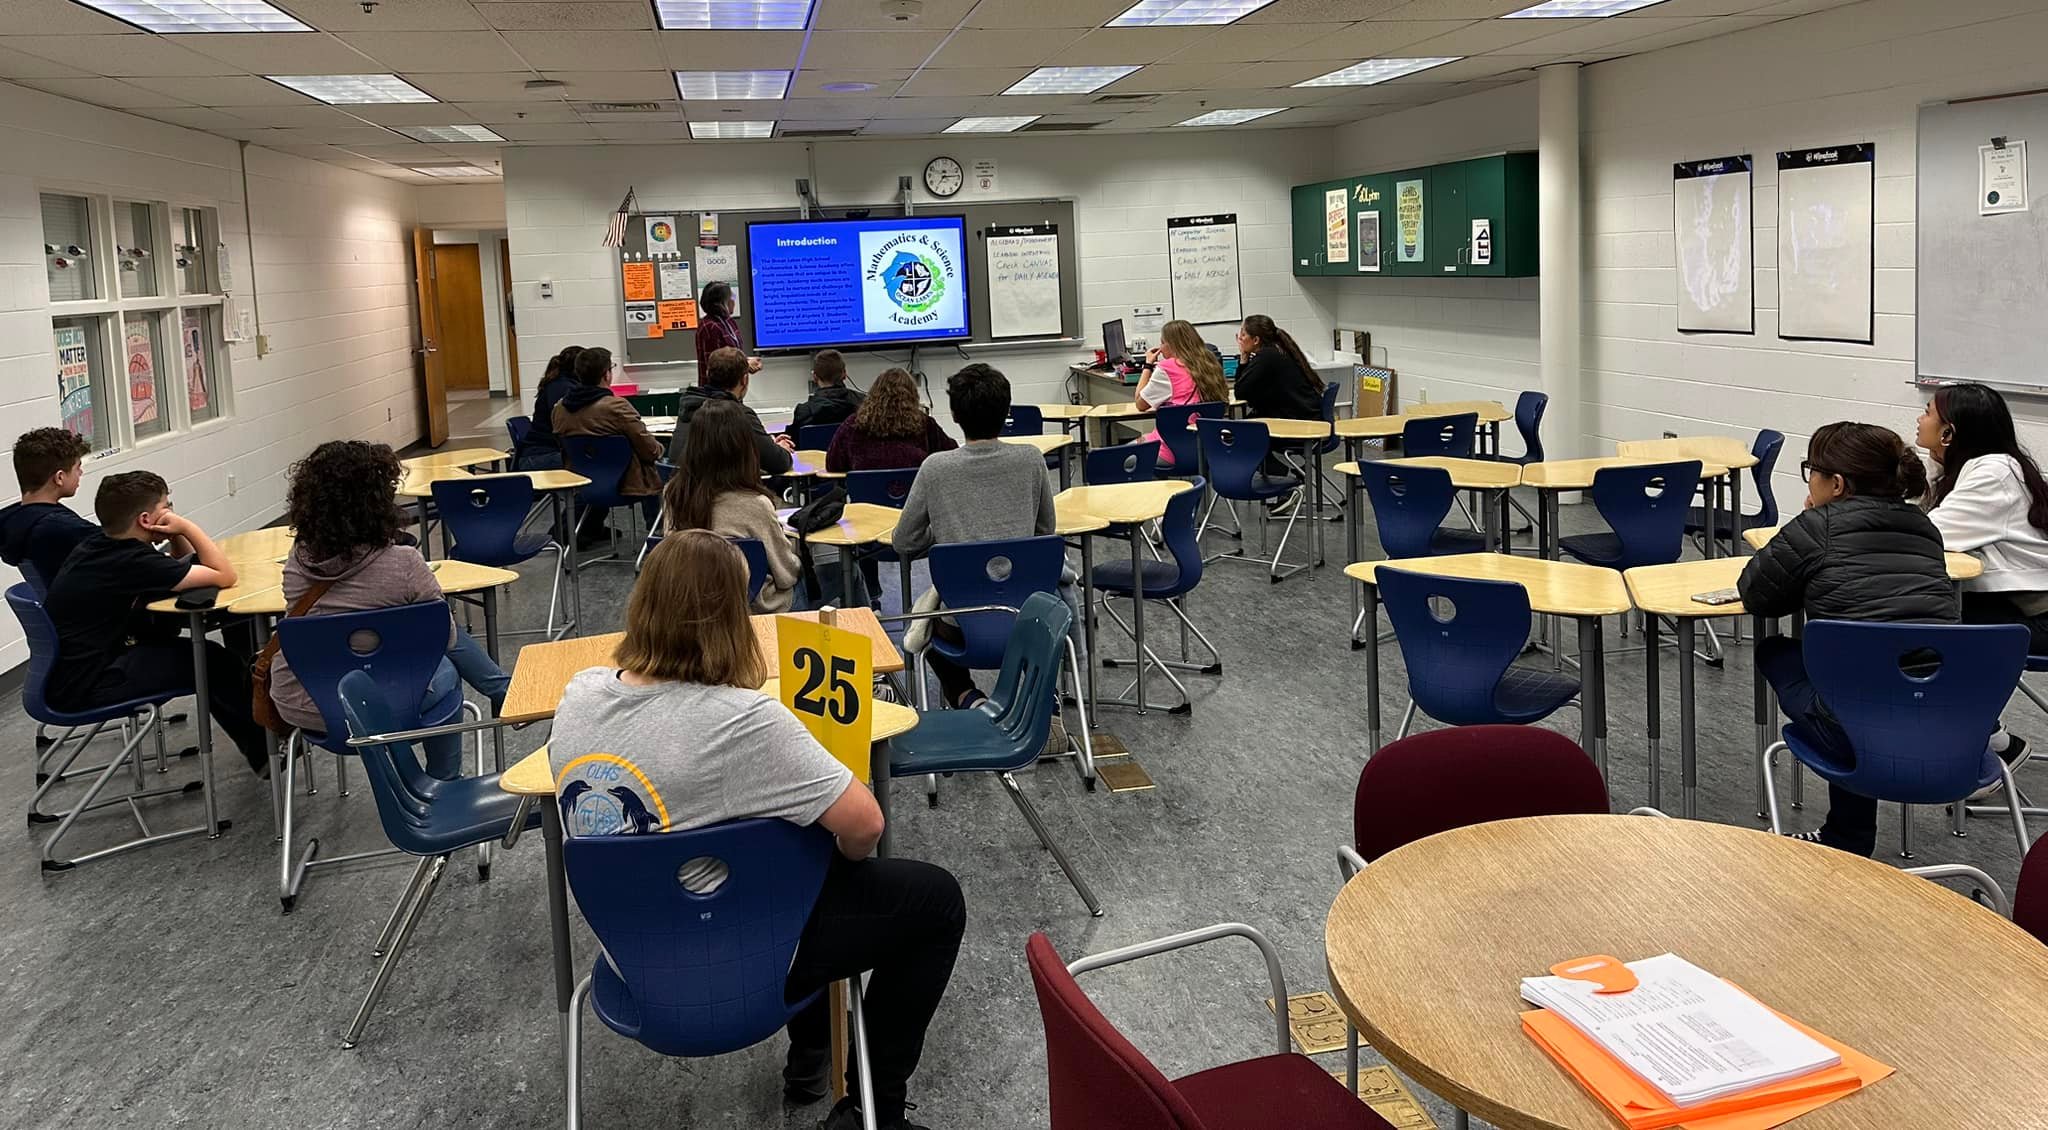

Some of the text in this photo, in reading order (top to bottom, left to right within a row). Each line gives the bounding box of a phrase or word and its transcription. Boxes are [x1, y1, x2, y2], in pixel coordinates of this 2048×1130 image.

[776, 236, 838, 247] Introduction
[866, 232, 954, 282] Mathematics & Science
[888, 310, 938, 325] Academy
[59, 346, 86, 365] MATTER
[793, 647, 860, 724] 25
[586, 764, 624, 782] OLHS
